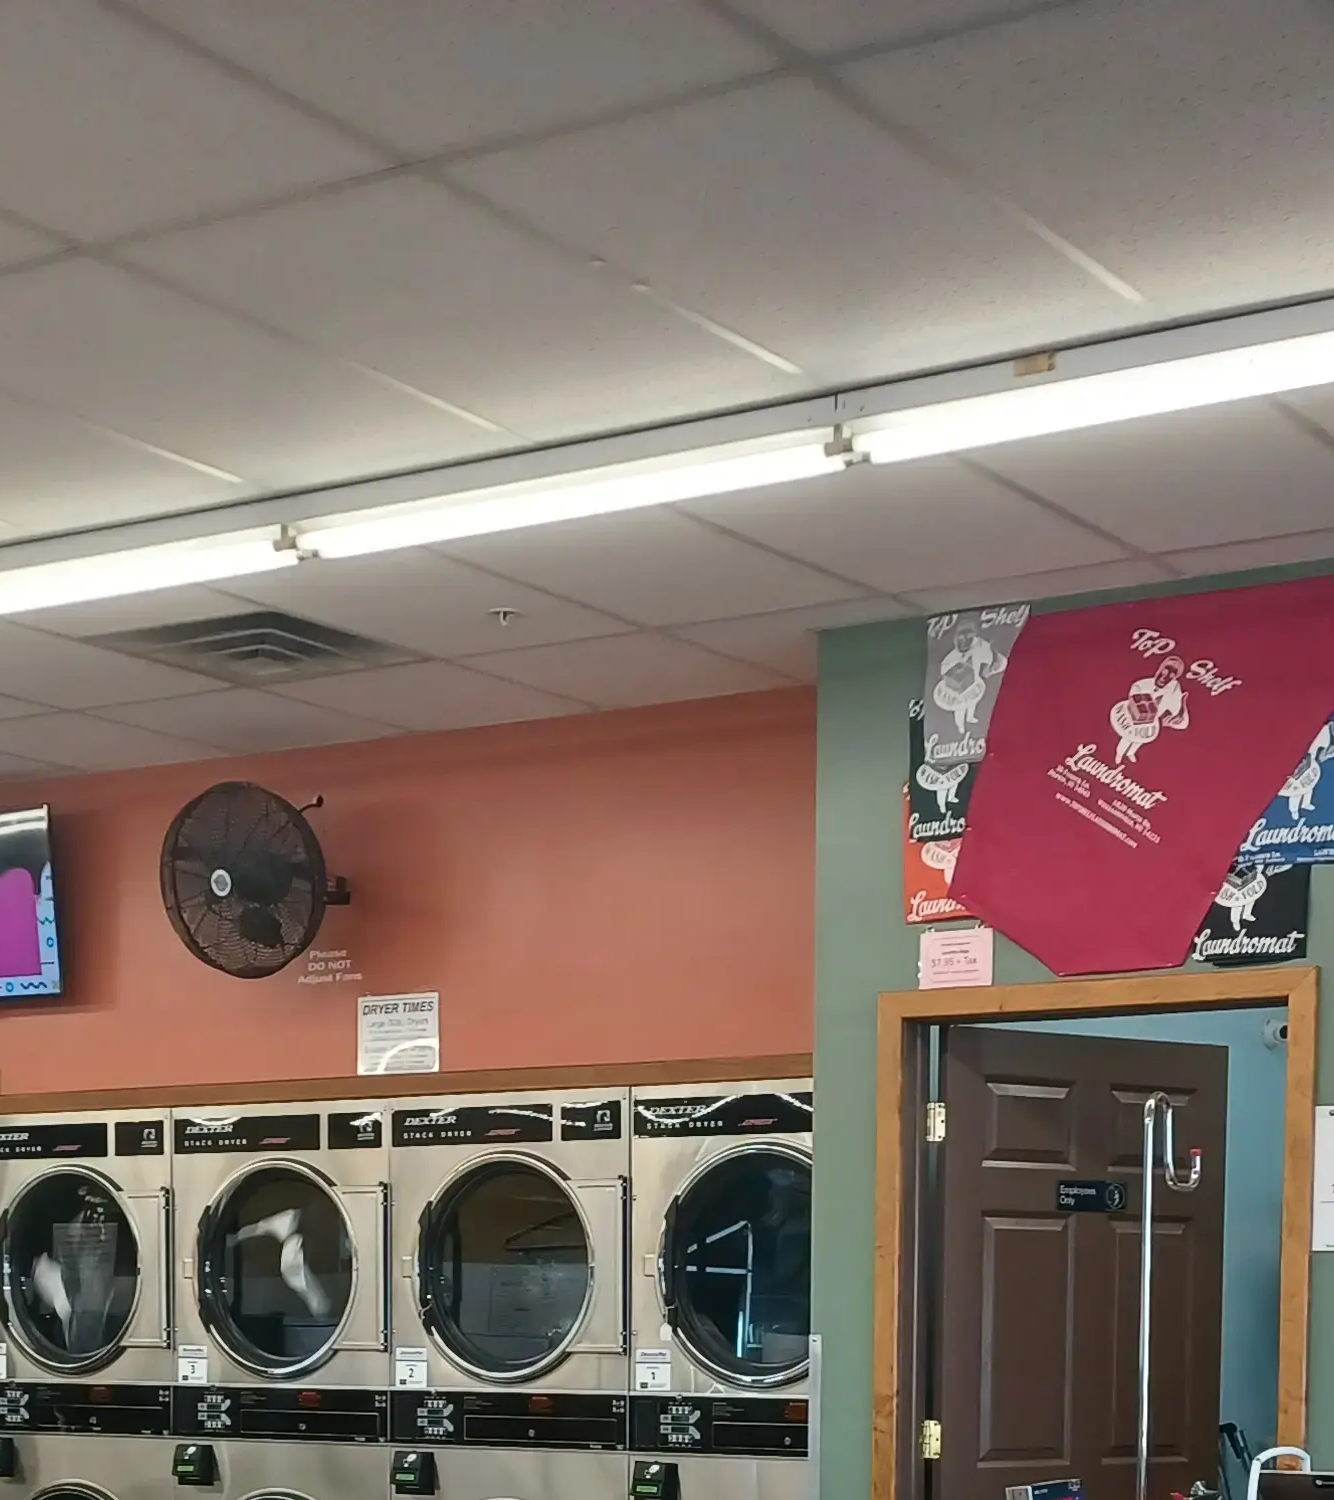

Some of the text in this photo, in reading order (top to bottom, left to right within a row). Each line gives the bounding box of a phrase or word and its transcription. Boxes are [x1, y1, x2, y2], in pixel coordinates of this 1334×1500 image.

[1185, 659, 1243, 696] Shelf
[1065, 743, 1168, 809] Laundromat
[1192, 928, 1305, 961] Laundromat
[308, 959, 352, 971] DO NOT
[362, 1000, 435, 1016] DRYER TIMES
[403, 1115, 457, 1126] DEXTER
[1059, 1195, 1075, 1206] Only
